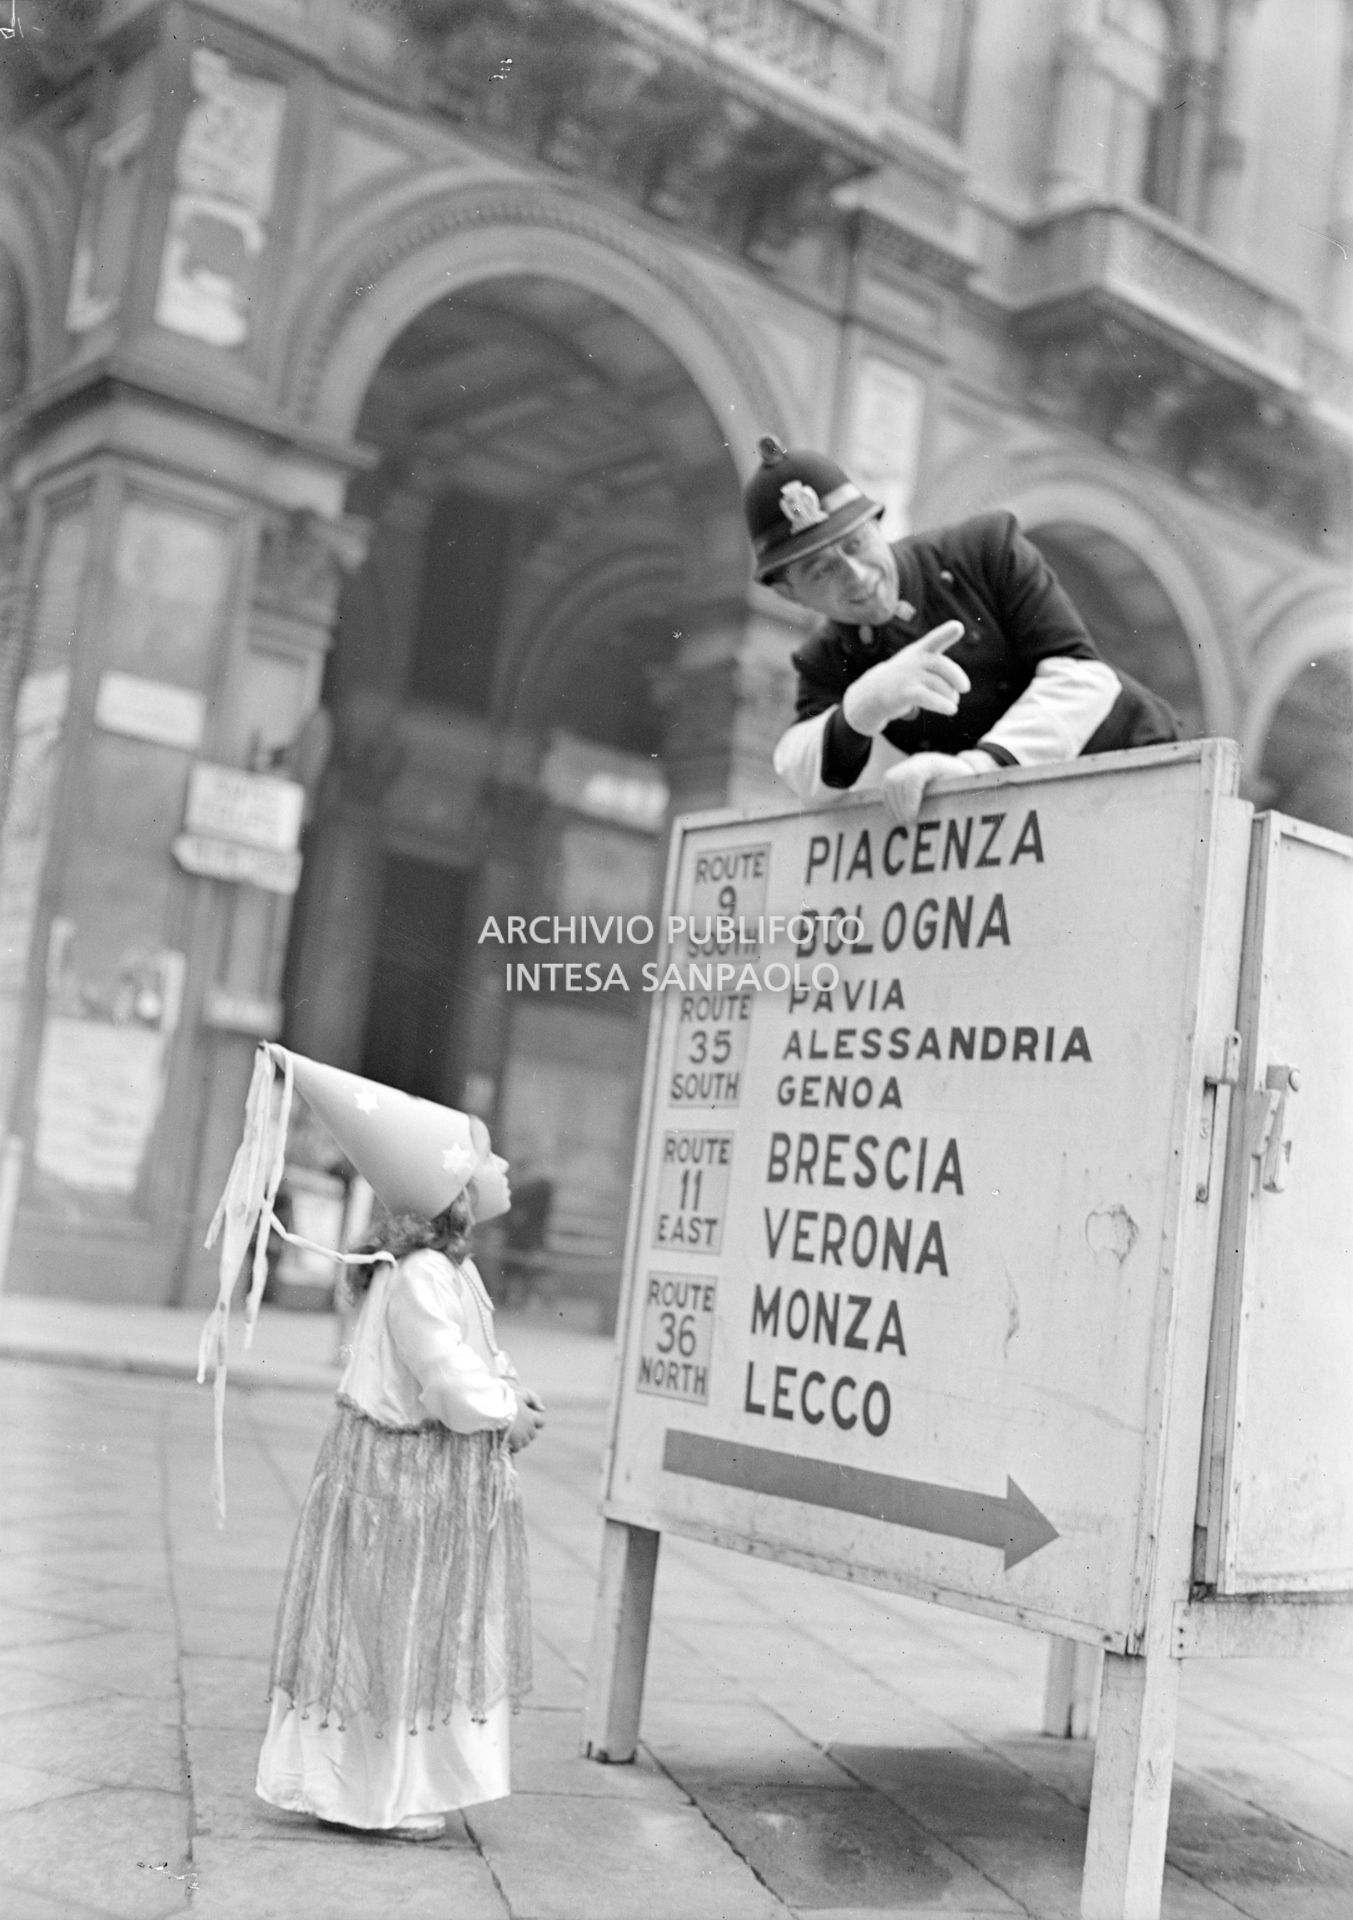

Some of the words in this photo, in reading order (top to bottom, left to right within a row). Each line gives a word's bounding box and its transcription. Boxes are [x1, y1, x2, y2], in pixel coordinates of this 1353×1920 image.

[805, 810, 1045, 885] PIACENZA
[696, 851, 766, 883] ROUTE
[718, 885, 737, 925] 9
[796, 894, 1012, 958] BOLOGNA
[679, 991, 751, 1023] ROUTE
[788, 979, 906, 1014] PAVIA
[689, 1030, 732, 1065] 35
[782, 1026, 1093, 1063] ALESSANDRIA
[670, 1072, 741, 1101] SOUTH
[777, 1076, 904, 1110] GENOA
[663, 1137, 731, 1166] ROUTE
[766, 1132, 965, 1196] BRESCIA
[679, 1170, 704, 1211] 11
[657, 1214, 718, 1247] EAST
[763, 1207, 949, 1277] VERONA
[648, 1279, 715, 1313] ROUTE
[656, 1313, 697, 1357] 36
[751, 1284, 907, 1357] MONZA
[639, 1357, 708, 1396] NORTH
[744, 1361, 892, 1437] LECCO
